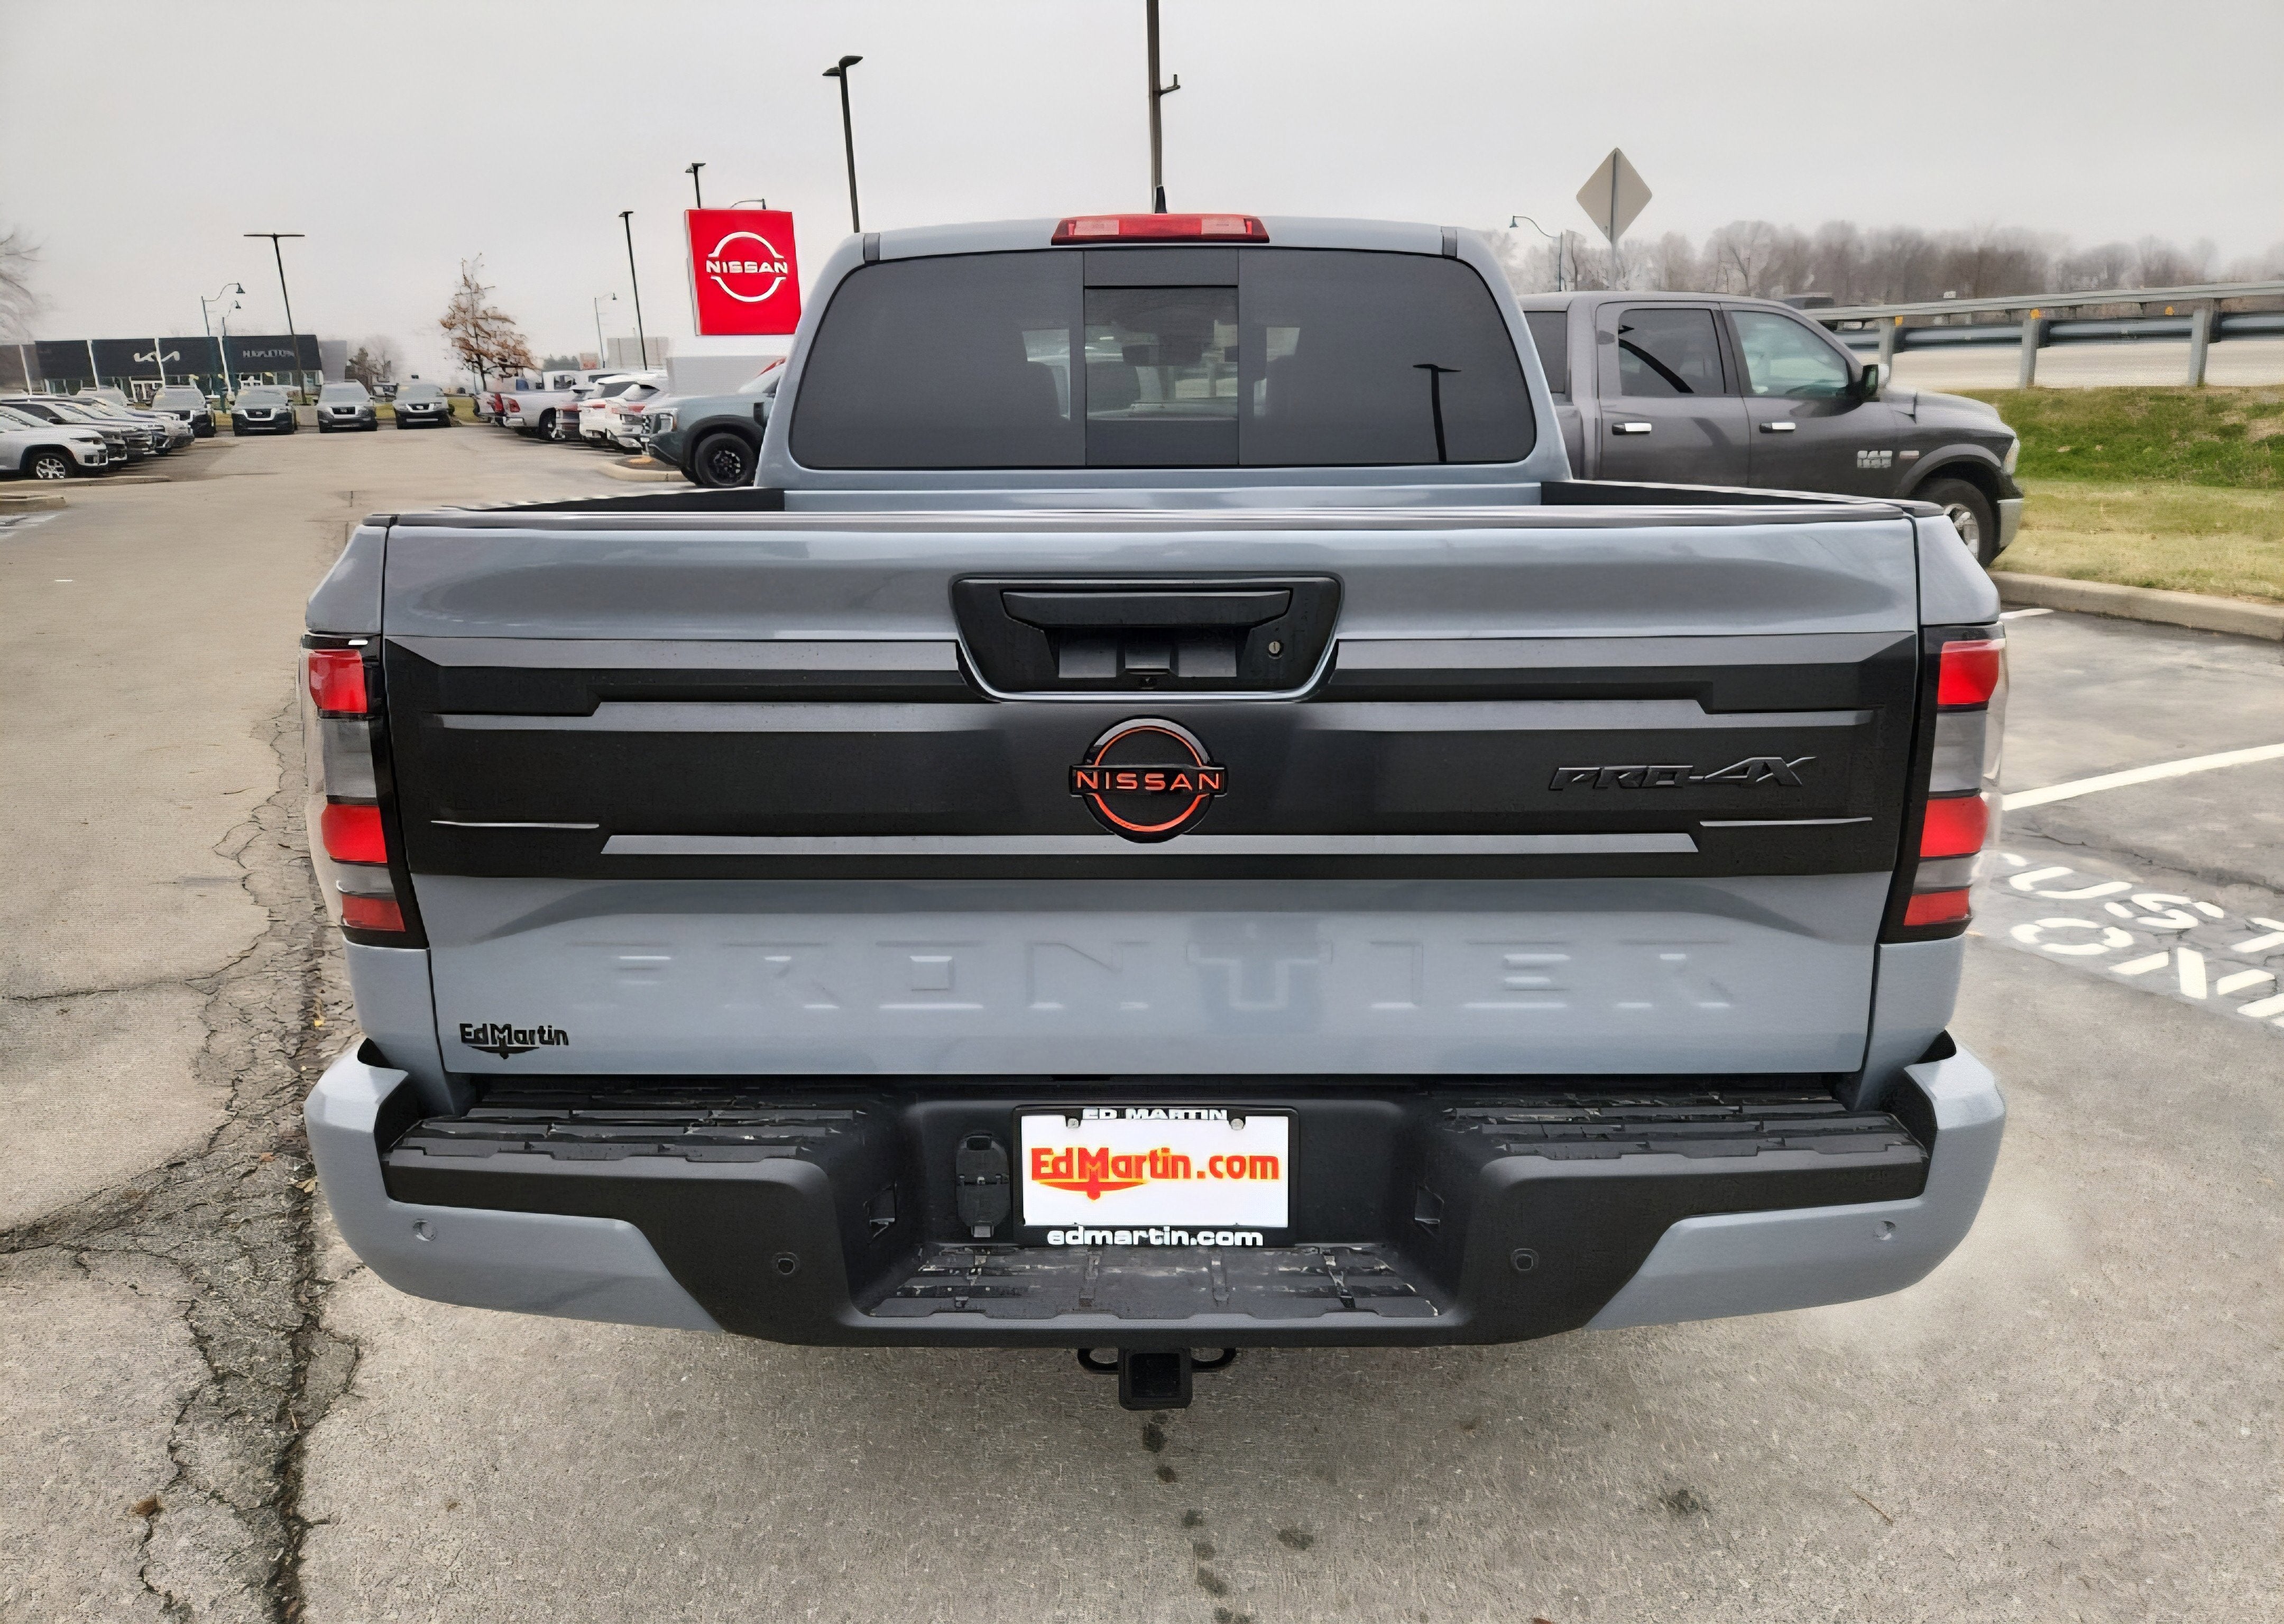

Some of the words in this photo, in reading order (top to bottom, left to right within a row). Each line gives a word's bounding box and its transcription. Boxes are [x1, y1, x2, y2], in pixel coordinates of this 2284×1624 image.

[706, 259, 788, 274] NISSAN
[1076, 770, 1220, 792] NISSAN
[1549, 756, 1817, 791] PRO-4X
[566, 940, 1734, 1010] FRONTIER
[459, 1023, 569, 1046] EdMartin
[1082, 1108, 1117, 1120] ED
[1126, 1108, 1228, 1120] MARTIN
[1031, 1147, 1279, 1180] EdMartin.com
[1047, 1226, 1264, 1247] edmartin.com
